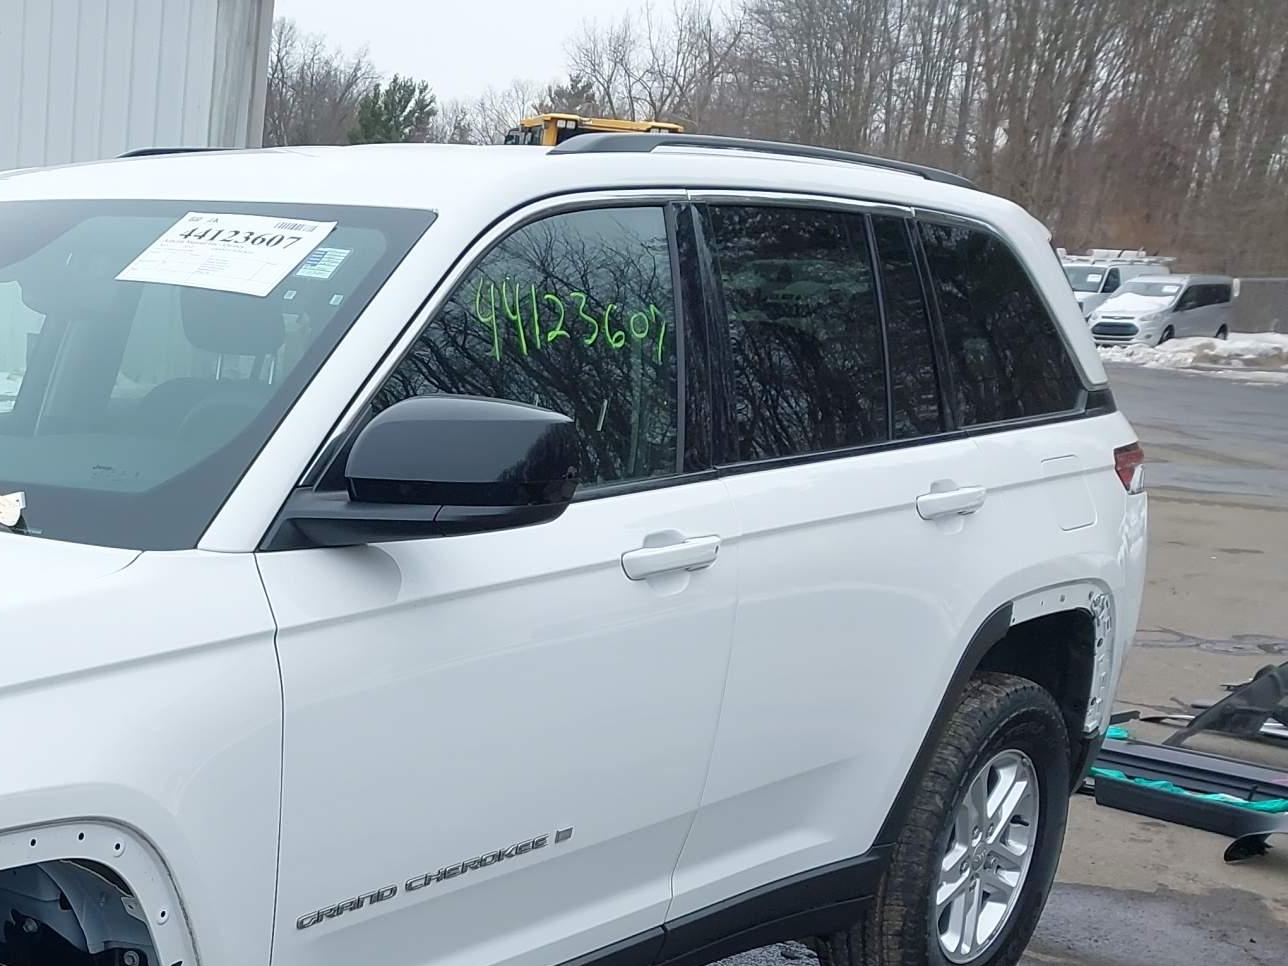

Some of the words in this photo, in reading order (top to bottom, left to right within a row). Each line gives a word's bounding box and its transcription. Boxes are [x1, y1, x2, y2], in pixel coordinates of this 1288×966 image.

[179, 227, 302, 250] 44123607
[475, 276, 667, 366] 44123607
[296, 884, 398, 931] GRAND
[404, 833, 550, 892] CHEROKEE
